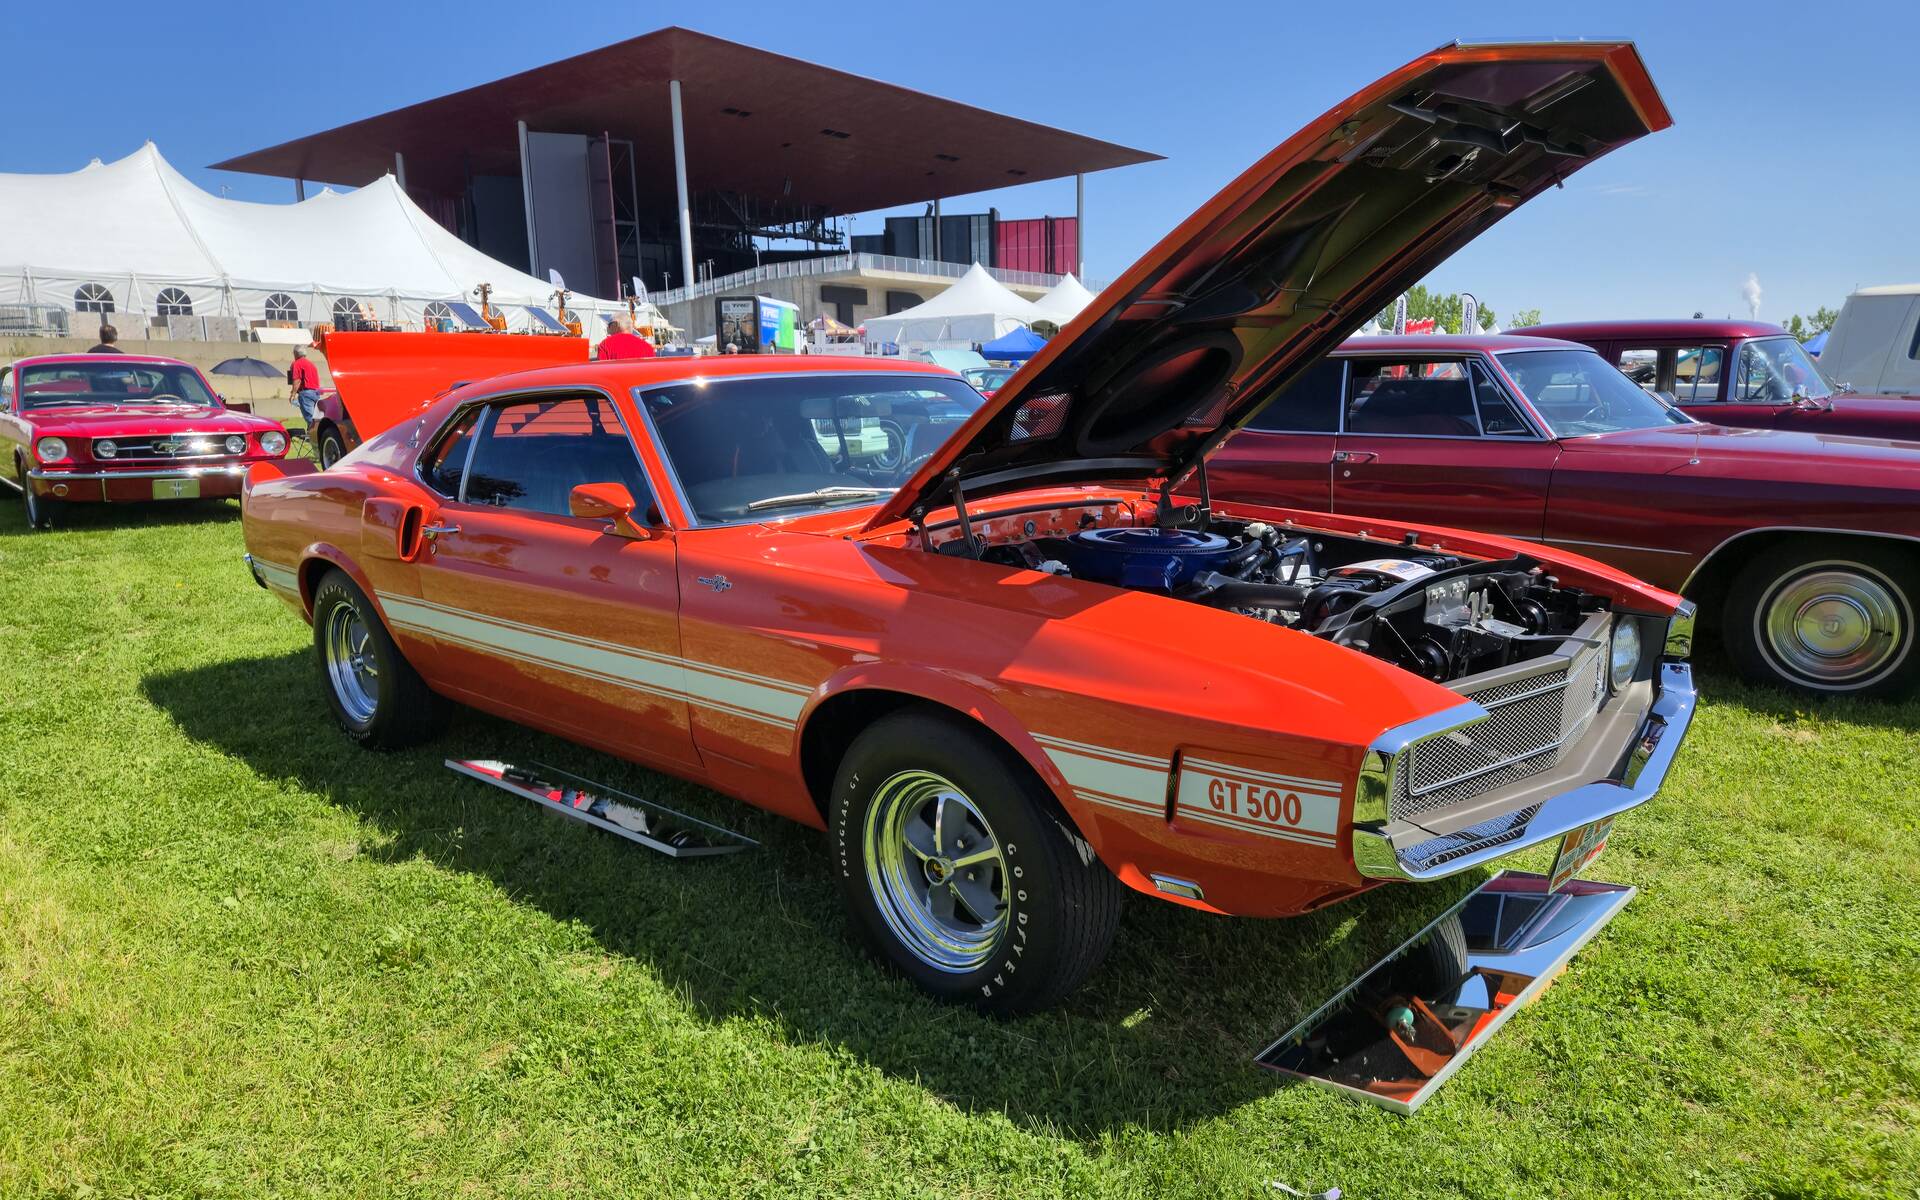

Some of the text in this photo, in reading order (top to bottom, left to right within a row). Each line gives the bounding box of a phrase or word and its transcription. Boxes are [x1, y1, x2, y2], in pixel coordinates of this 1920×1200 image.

[839, 773, 860, 877] POLYGLAS GT
[982, 843, 1028, 998] GOODYEAR
